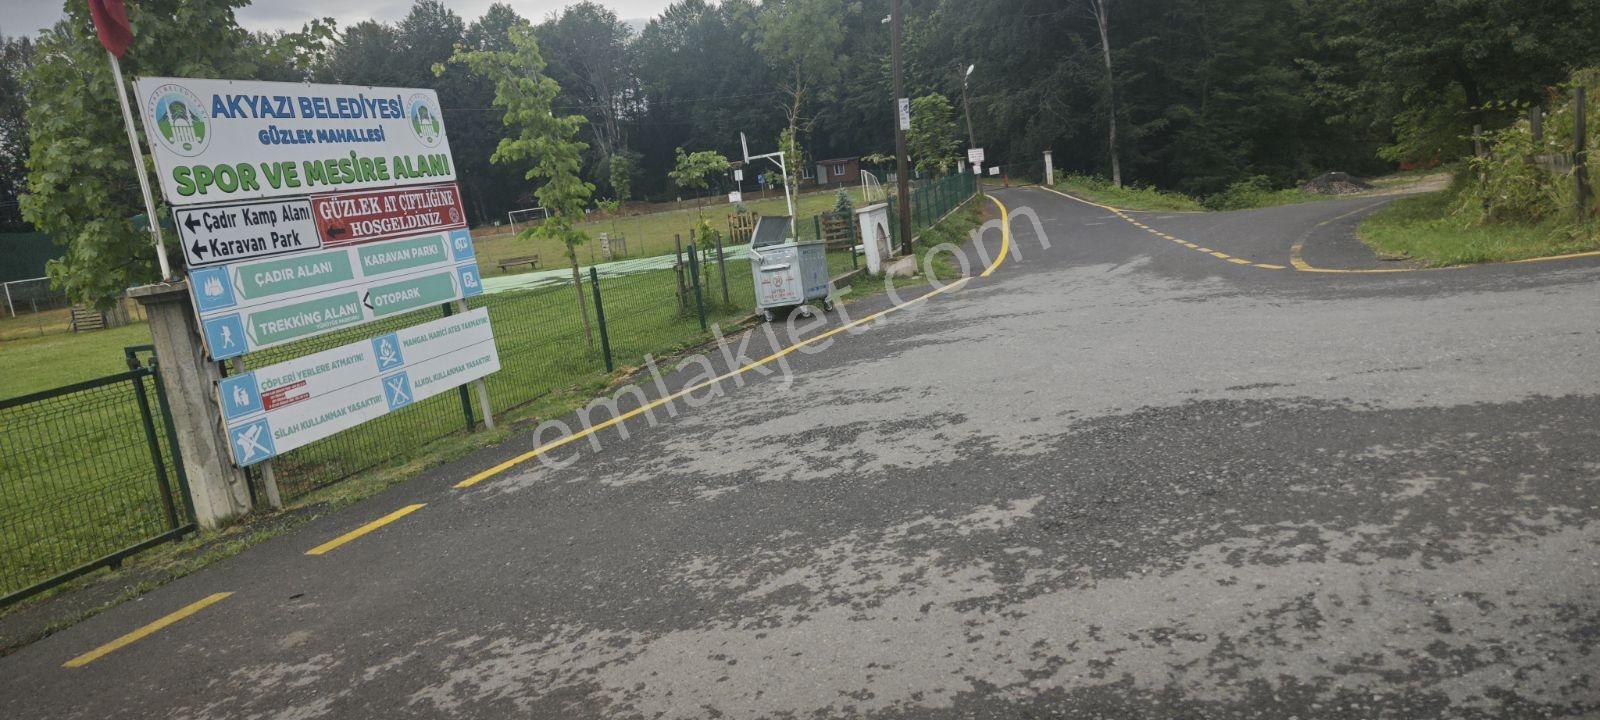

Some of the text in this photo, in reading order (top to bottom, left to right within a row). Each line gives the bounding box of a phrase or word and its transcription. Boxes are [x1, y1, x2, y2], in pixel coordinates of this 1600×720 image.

[211, 94, 296, 119] AKYAZI
[299, 93, 405, 119] BELEDİYESİ
[258, 124, 385, 145] GÜZLEK MAHALLESİ
[172, 150, 450, 197] SPOR VE MESİRE ALANI
[319, 189, 455, 220] GÜZLEK AT ÇİFTLİĞİNE
[202, 205, 311, 232] Çadır Kamp Alanı
[350, 209, 442, 236] HOŞGELDİNİZ
[209, 229, 301, 257] Karavan Park
[364, 244, 438, 267] KARAVAN PARKI
[255, 262, 333, 287] ÇADIR ALANI
[374, 287, 421, 307] OTOPARK
[324, 302, 358, 321] ALANI
[402, 334, 428, 348] MANGAL
[261, 371, 296, 391] ÇÖPLERİ
[296, 363, 331, 380] YERLERE
[331, 353, 364, 370] ATMAYIN!
[414, 376, 434, 389] ALKOL
[433, 363, 466, 381] KULLANMAK
[274, 422, 301, 440] SİLAH
[300, 407, 347, 430] KULLANMAK
